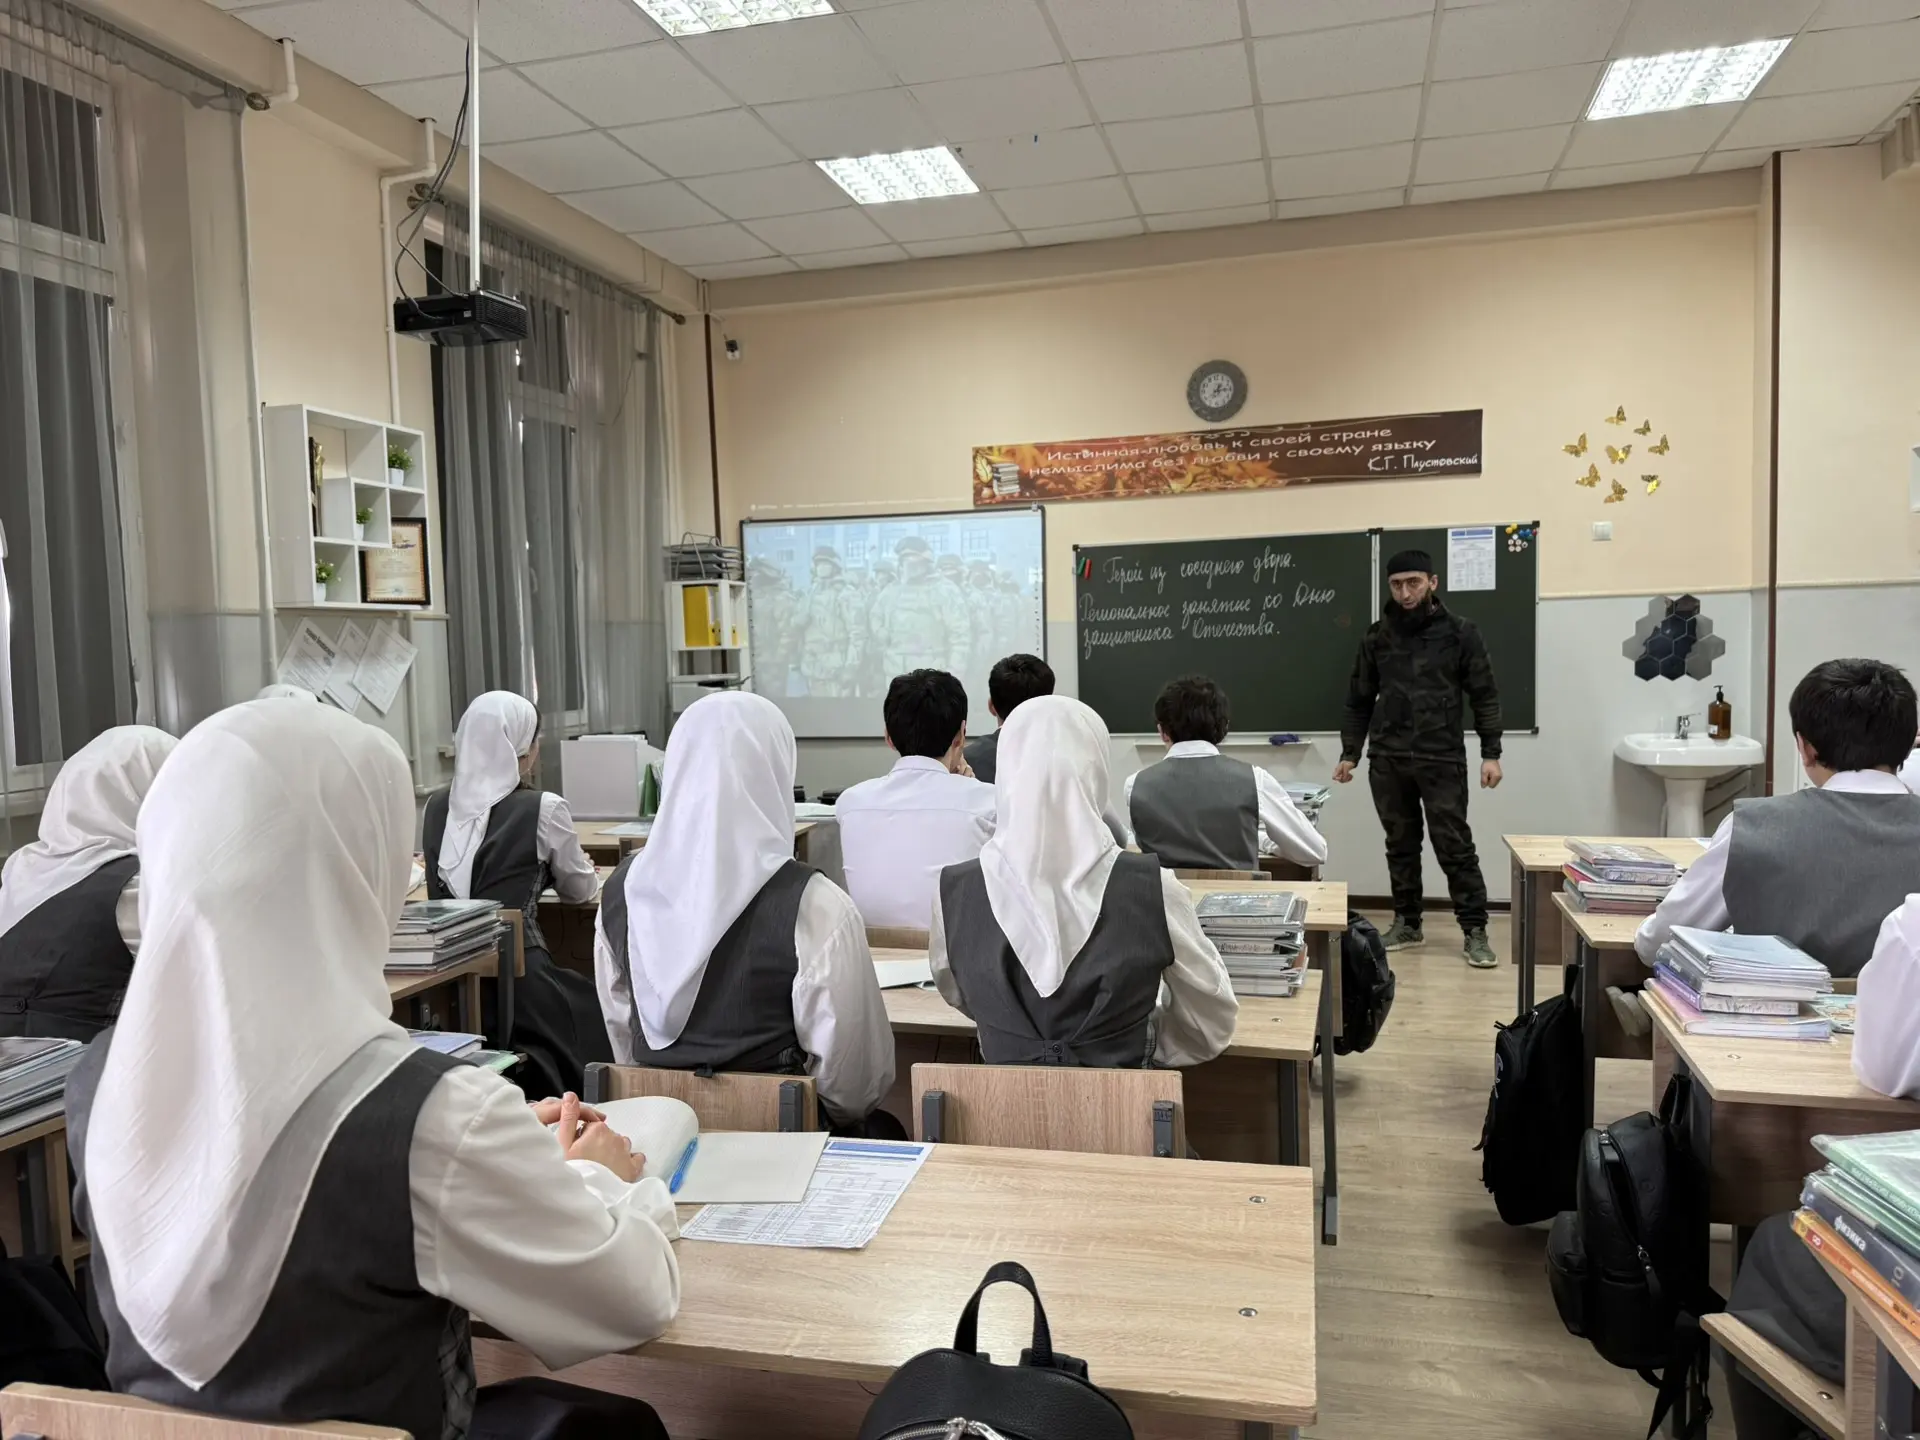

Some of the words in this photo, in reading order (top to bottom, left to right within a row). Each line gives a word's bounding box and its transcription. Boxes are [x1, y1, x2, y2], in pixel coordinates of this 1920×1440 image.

[1029, 461, 1146, 477] немыслима
[1152, 457, 1184, 468] без
[1192, 451, 1260, 466] любви
[1268, 450, 1279, 459] к
[1286, 444, 1364, 458] своему
[1371, 439, 1436, 452] языку
[1048, 447, 1139, 461] Истинная
[1147, 440, 1225, 456] любовь
[1232, 440, 1243, 448] к
[1250, 432, 1311, 446] своей
[1319, 428, 1393, 443] стране
[1103, 556, 1143, 594] Герой
[1150, 566, 1167, 594] из
[1180, 559, 1245, 589] соседнего
[1079, 592, 1170, 621] Региональное
[1181, 598, 1251, 630] занятие
[1262, 592, 1283, 610] ко
[1292, 581, 1335, 608] Дню
[1083, 627, 1174, 660] защитника
[1192, 612, 1280, 639] Отечества.
